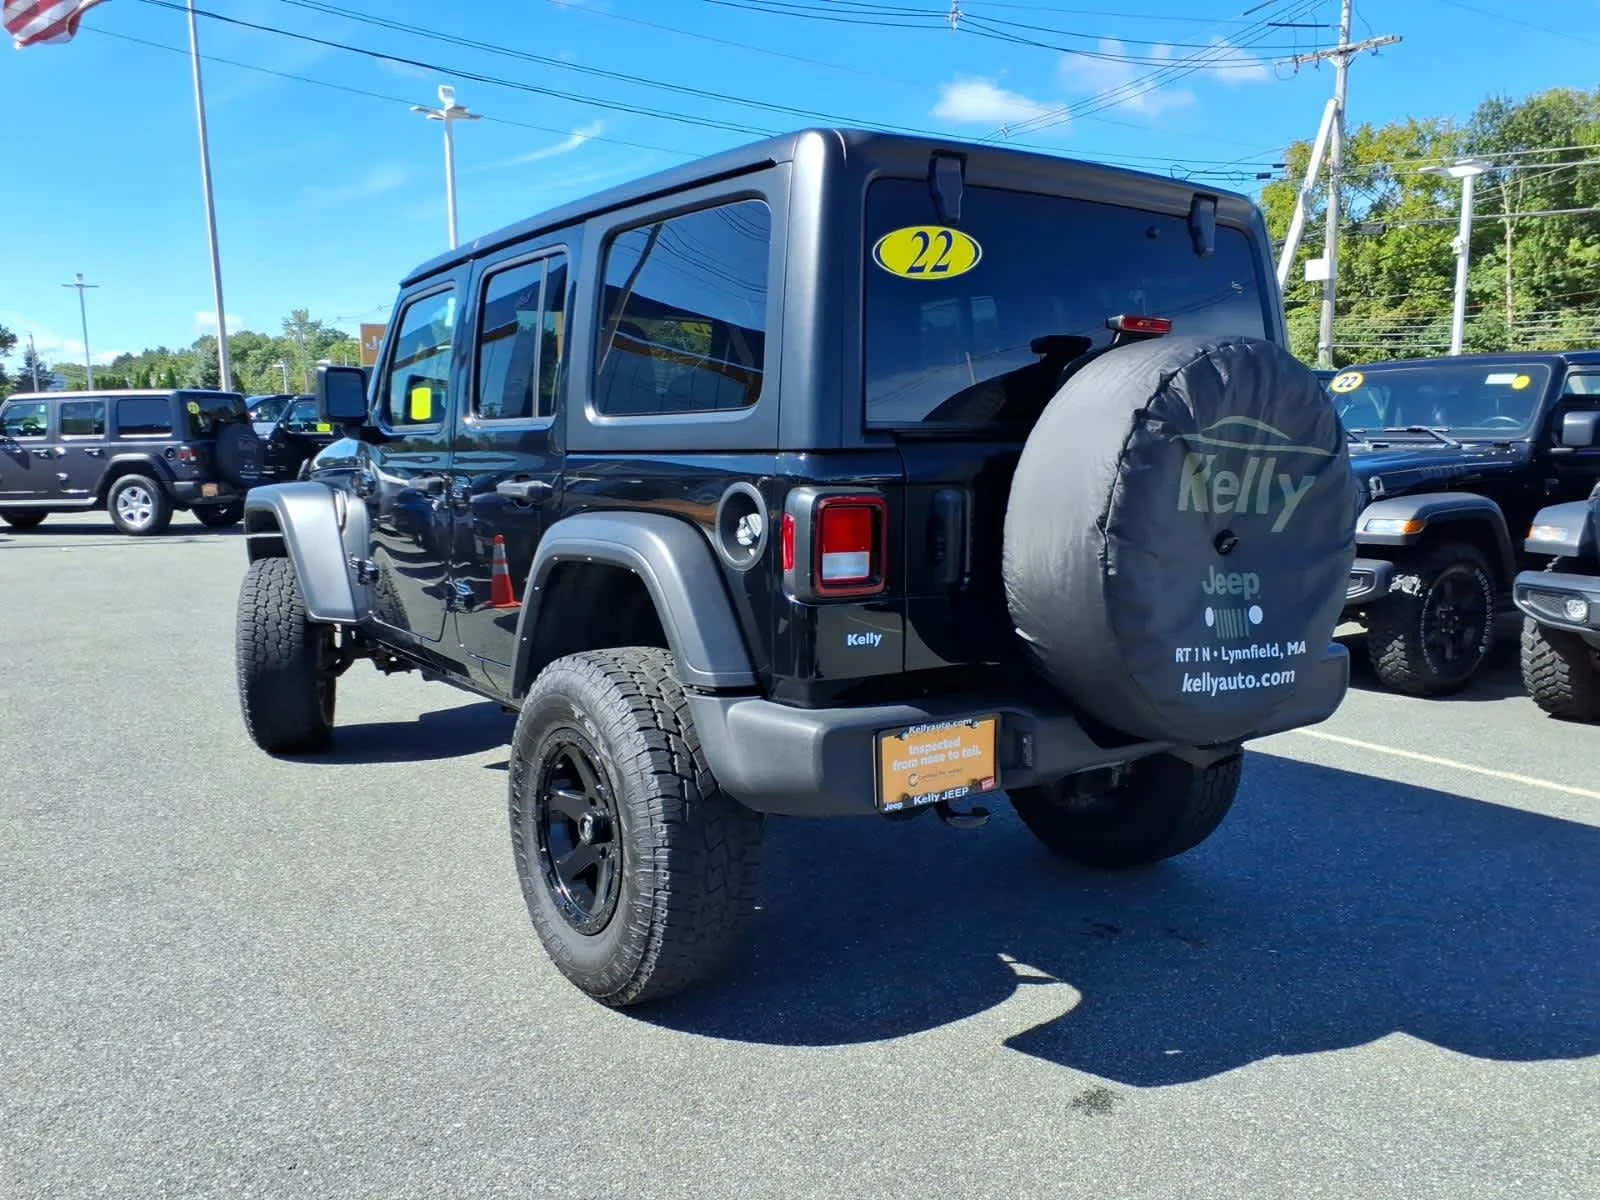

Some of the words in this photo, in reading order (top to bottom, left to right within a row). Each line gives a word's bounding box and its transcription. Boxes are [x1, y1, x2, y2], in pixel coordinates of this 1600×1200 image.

[905, 230, 953, 273] 22
[1337, 376, 1358, 388] 22
[1177, 453, 1316, 533] Kelly
[1202, 565, 1260, 600] Jeep
[847, 632, 882, 647] Kelly
[1175, 648, 1192, 663] RT
[1202, 647, 1210, 662] N
[1221, 643, 1284, 664] Lynnfield,
[1287, 640, 1307, 656] MA
[1182, 670, 1295, 697] kellyauto.com
[908, 736, 961, 755] Inspected
[892, 758, 919, 772] from
[947, 749, 960, 760] to
[884, 802, 903, 812] Jeep
[913, 792, 940, 806] Kelly
[941, 787, 969, 801] JEEP
